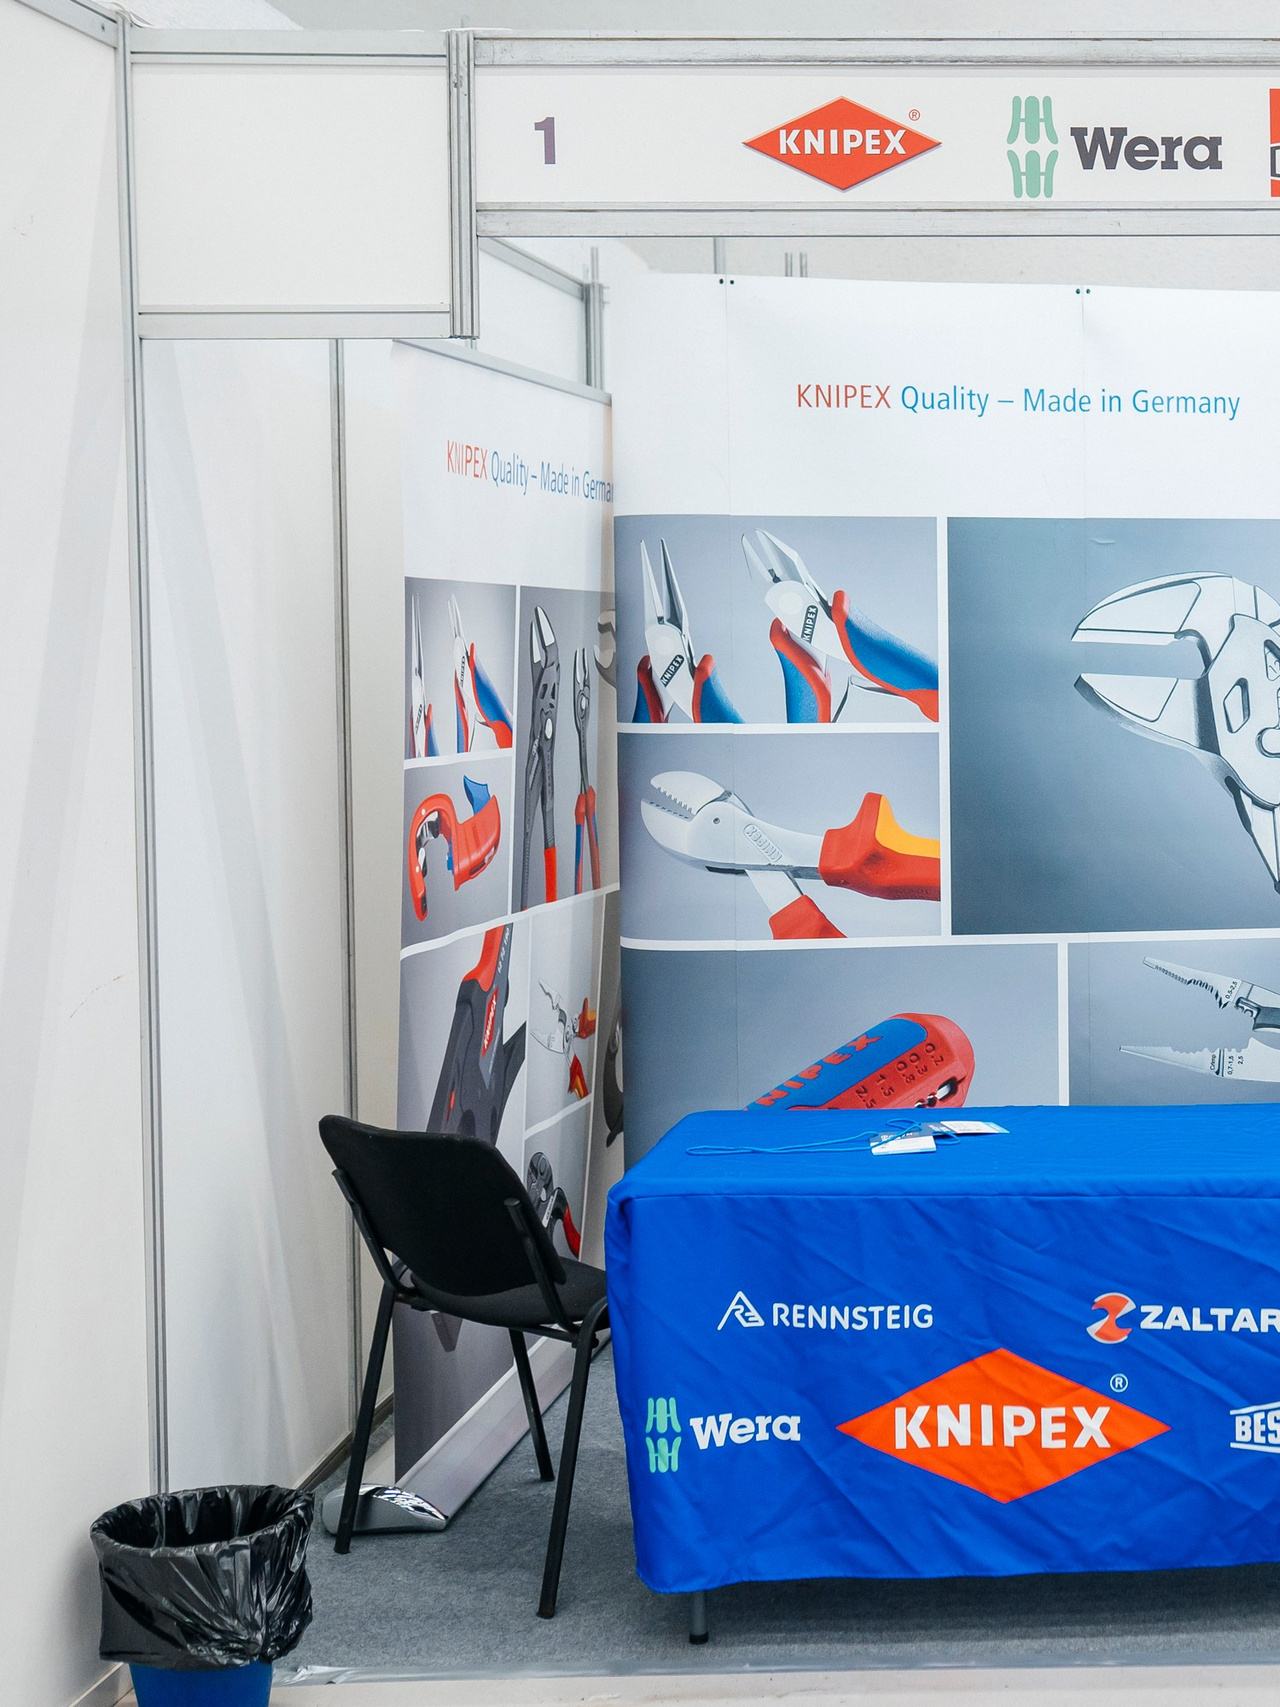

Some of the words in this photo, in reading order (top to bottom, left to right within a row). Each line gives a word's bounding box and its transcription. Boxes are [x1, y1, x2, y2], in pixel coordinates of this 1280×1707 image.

[533, 115, 557, 165] 1
[777, 128, 907, 156] KNIPEX
[1070, 126, 1223, 171] Wera
[796, 383, 892, 409] KNIPEX
[900, 385, 990, 418] Quality
[1023, 388, 1092, 413] Made
[1101, 388, 1122, 413] in
[1132, 389, 1241, 421] Germany
[447, 440, 488, 480] KNIPEX
[491, 450, 529, 496] Quality
[540, 461, 568, 495] Made
[572, 469, 580, 498] in
[802, 605, 818, 642] KNIPEX
[660, 655, 684, 687] KNIPEX
[908, 1053, 928, 1076] 0.3
[923, 1042, 945, 1067] 0.2
[743, 1034, 883, 1111] NIPEX
[875, 1074, 895, 1098] 1.5
[896, 1060, 916, 1084] 0.8
[854, 1085, 877, 1109] 2.5
[772, 1302, 933, 1331] RENNSTEIG
[690, 1411, 801, 1451] Wera
[895, 1404, 1112, 1450] KNIPEX
